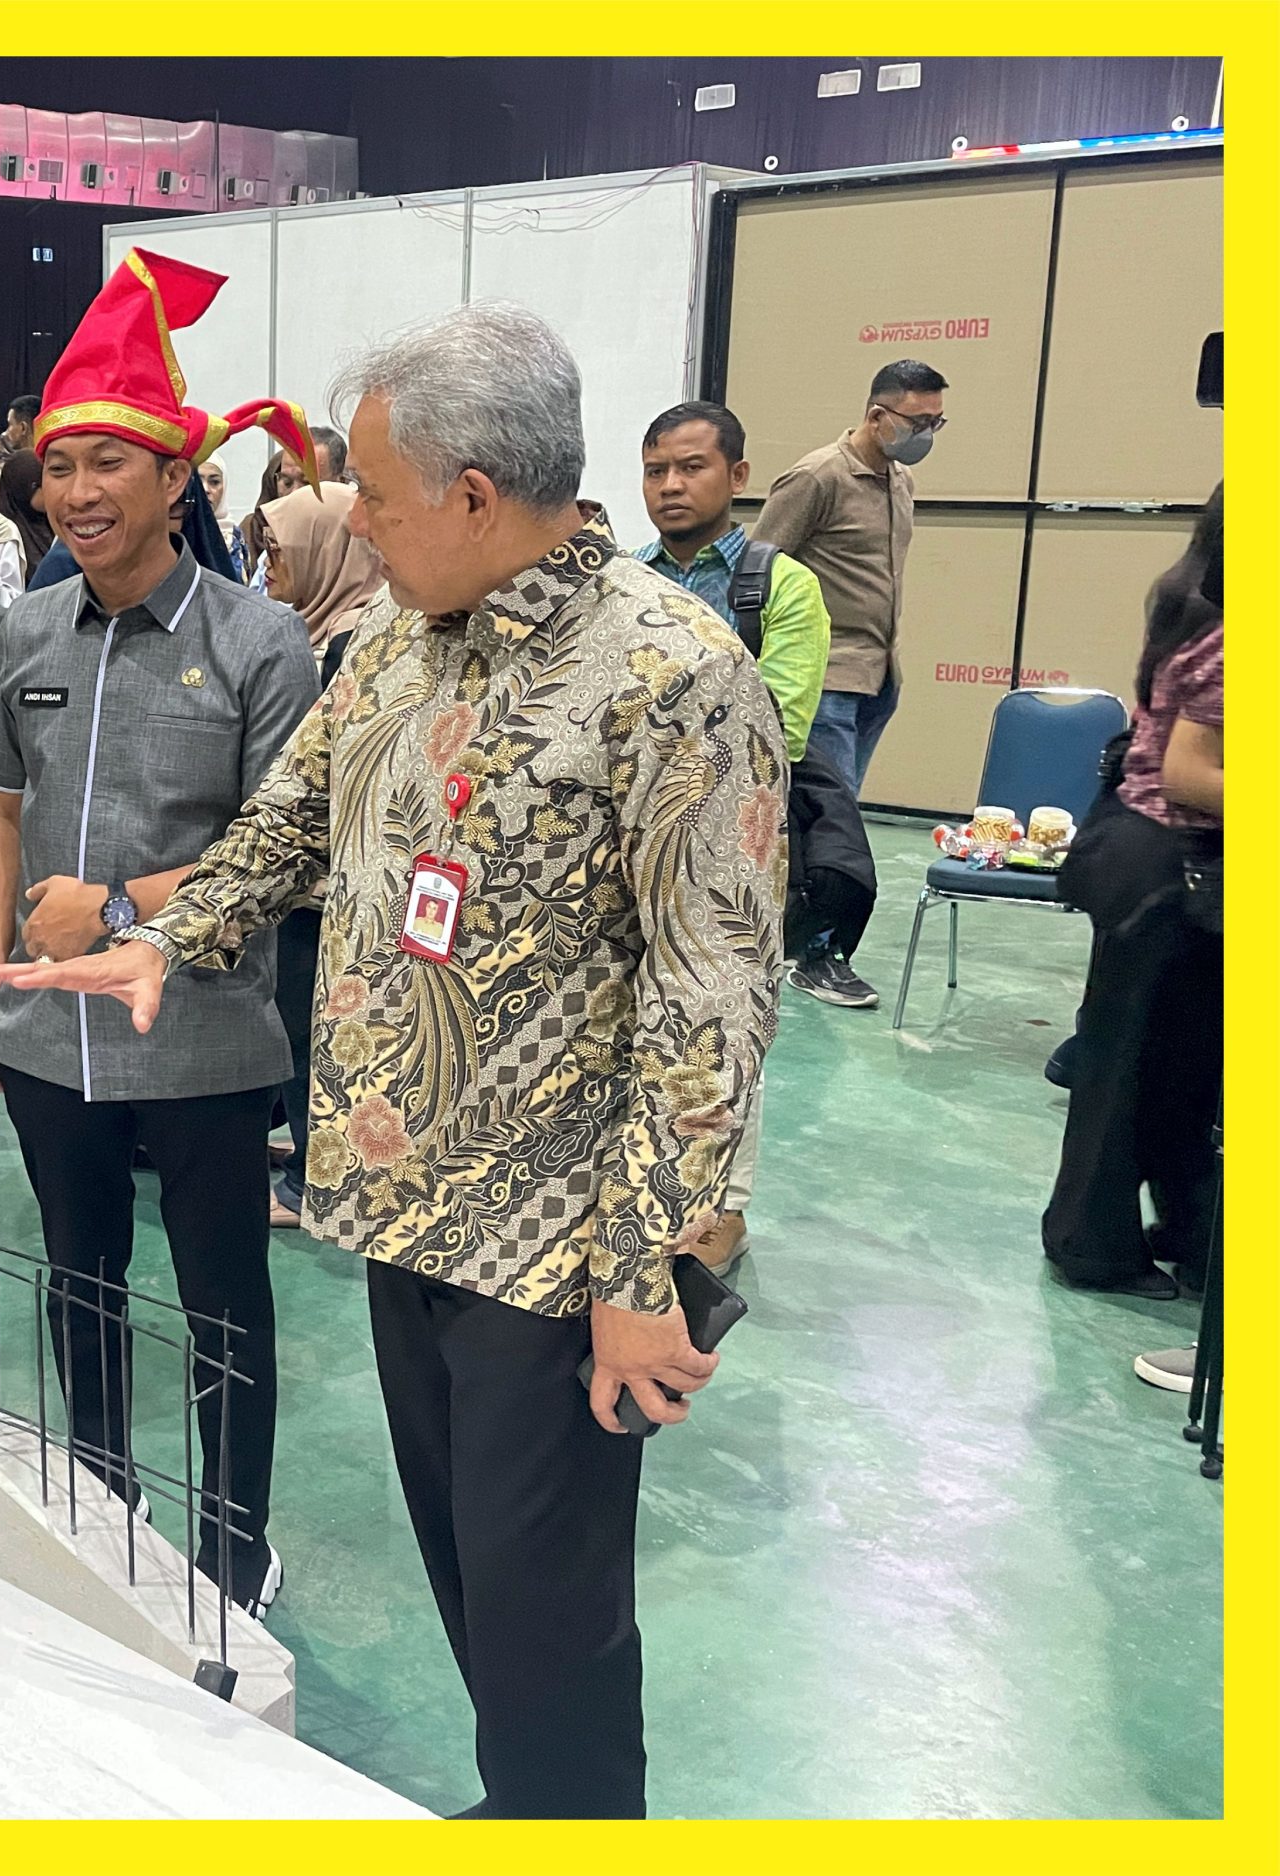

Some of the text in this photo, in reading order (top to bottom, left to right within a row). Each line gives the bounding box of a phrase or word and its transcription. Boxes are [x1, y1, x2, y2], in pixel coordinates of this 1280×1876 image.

[881, 318, 990, 342] EURO GYPSUM
[935, 663, 979, 684] EURO
[981, 666, 1046, 682] GYPUM
[24, 693, 62, 702] ANDI IHSAN
